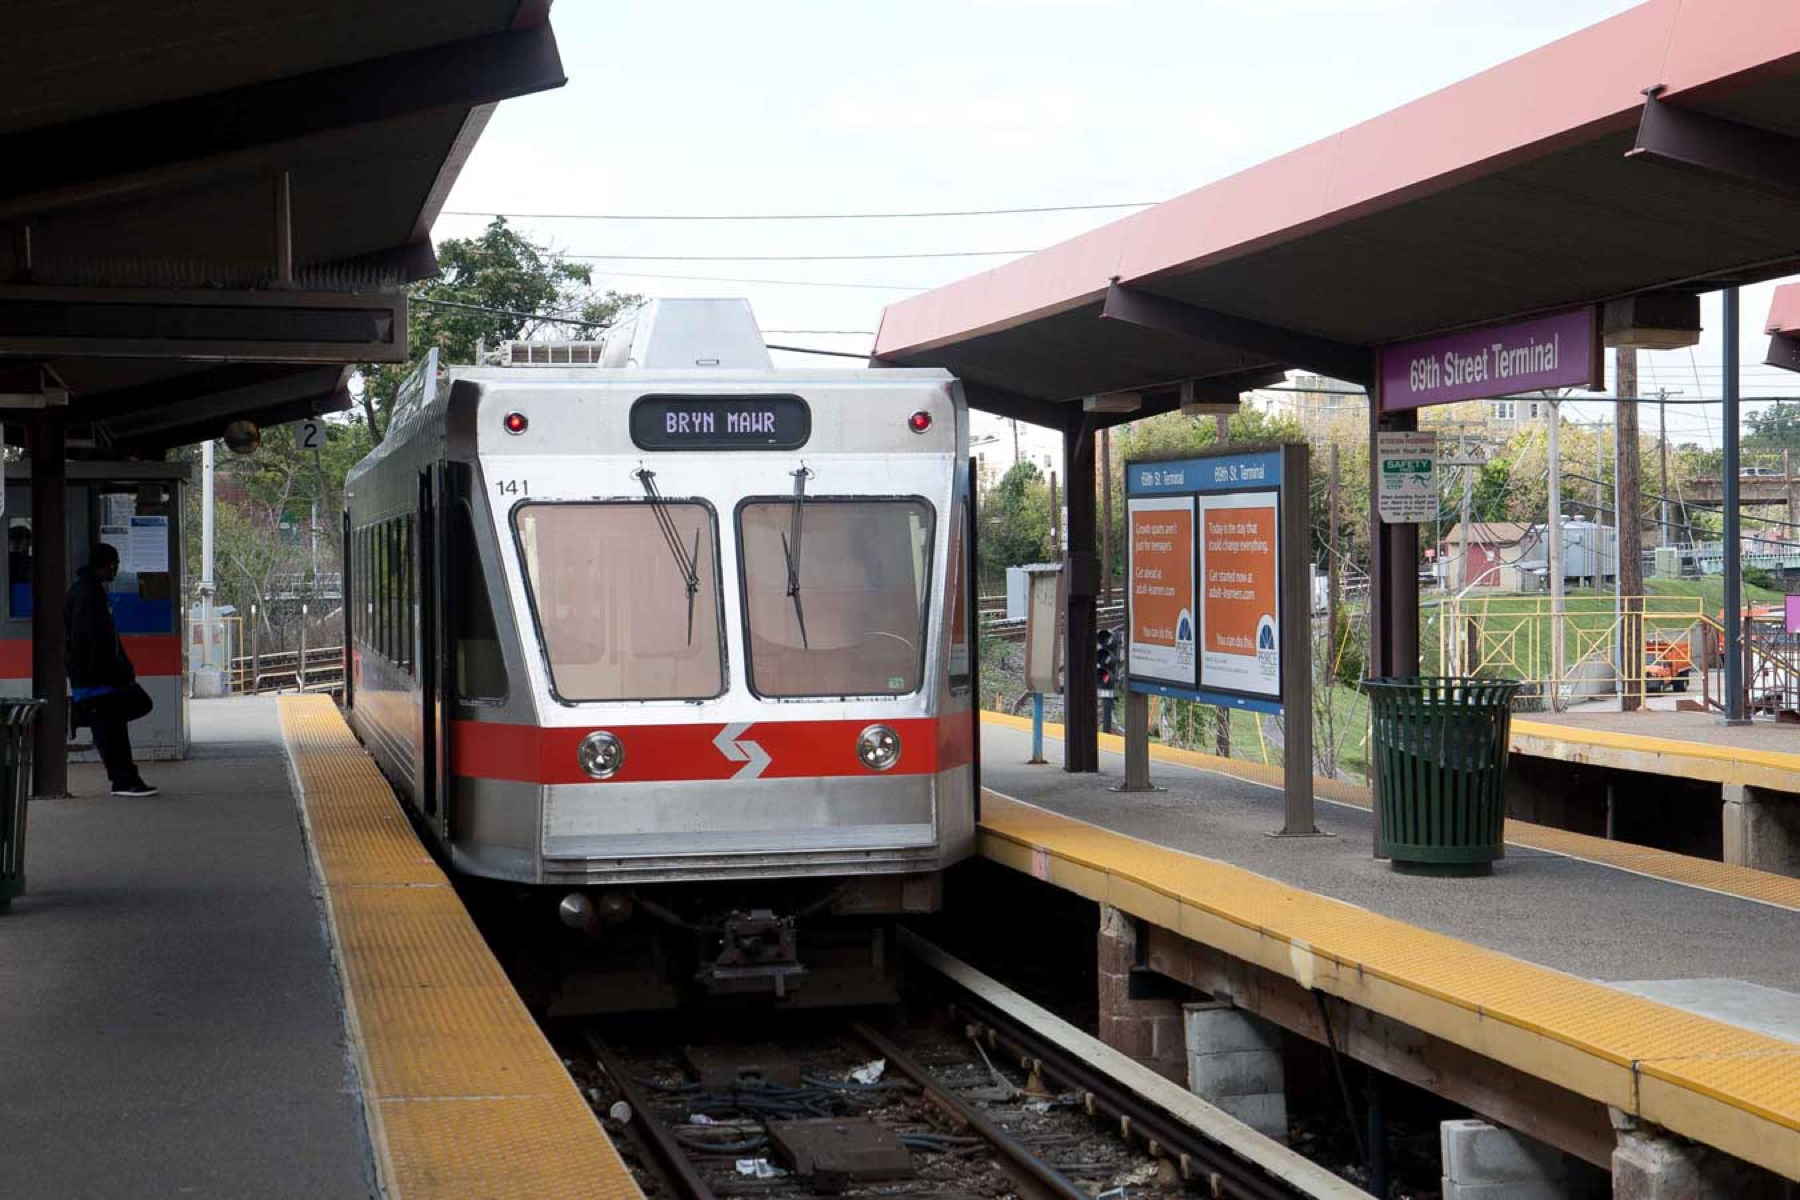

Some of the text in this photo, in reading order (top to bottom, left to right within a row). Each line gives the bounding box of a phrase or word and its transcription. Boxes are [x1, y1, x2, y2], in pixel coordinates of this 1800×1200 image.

[1410, 332, 1559, 392] 69th Street Terminal
[666, 412, 775, 433] BRYN MAWR
[304, 423, 317, 448] 2
[1240, 463, 1265, 481] Terminal
[1386, 460, 1428, 469] SAFETY
[496, 479, 528, 496] 141
